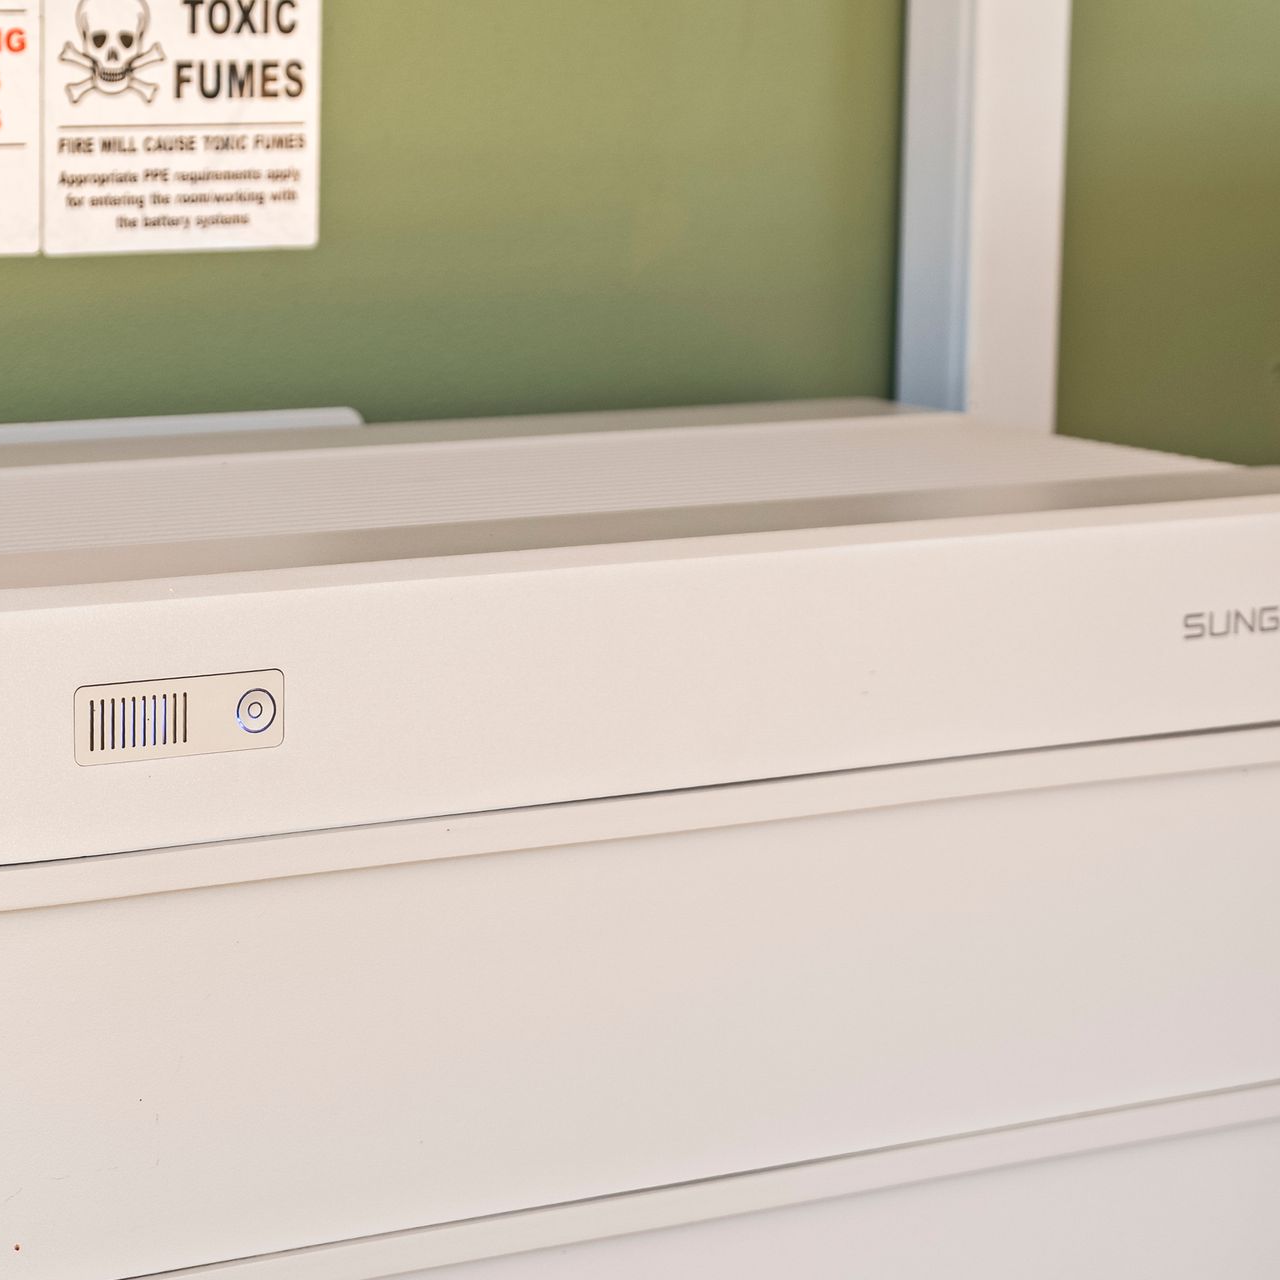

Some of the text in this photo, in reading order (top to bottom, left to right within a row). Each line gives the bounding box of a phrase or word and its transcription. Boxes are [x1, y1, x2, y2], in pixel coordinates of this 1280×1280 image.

[183, 0, 297, 34] TOXIC
[175, 60, 304, 99] FUMES
[58, 133, 306, 153] FIRE WILL CAUSE TOXIC FUMES
